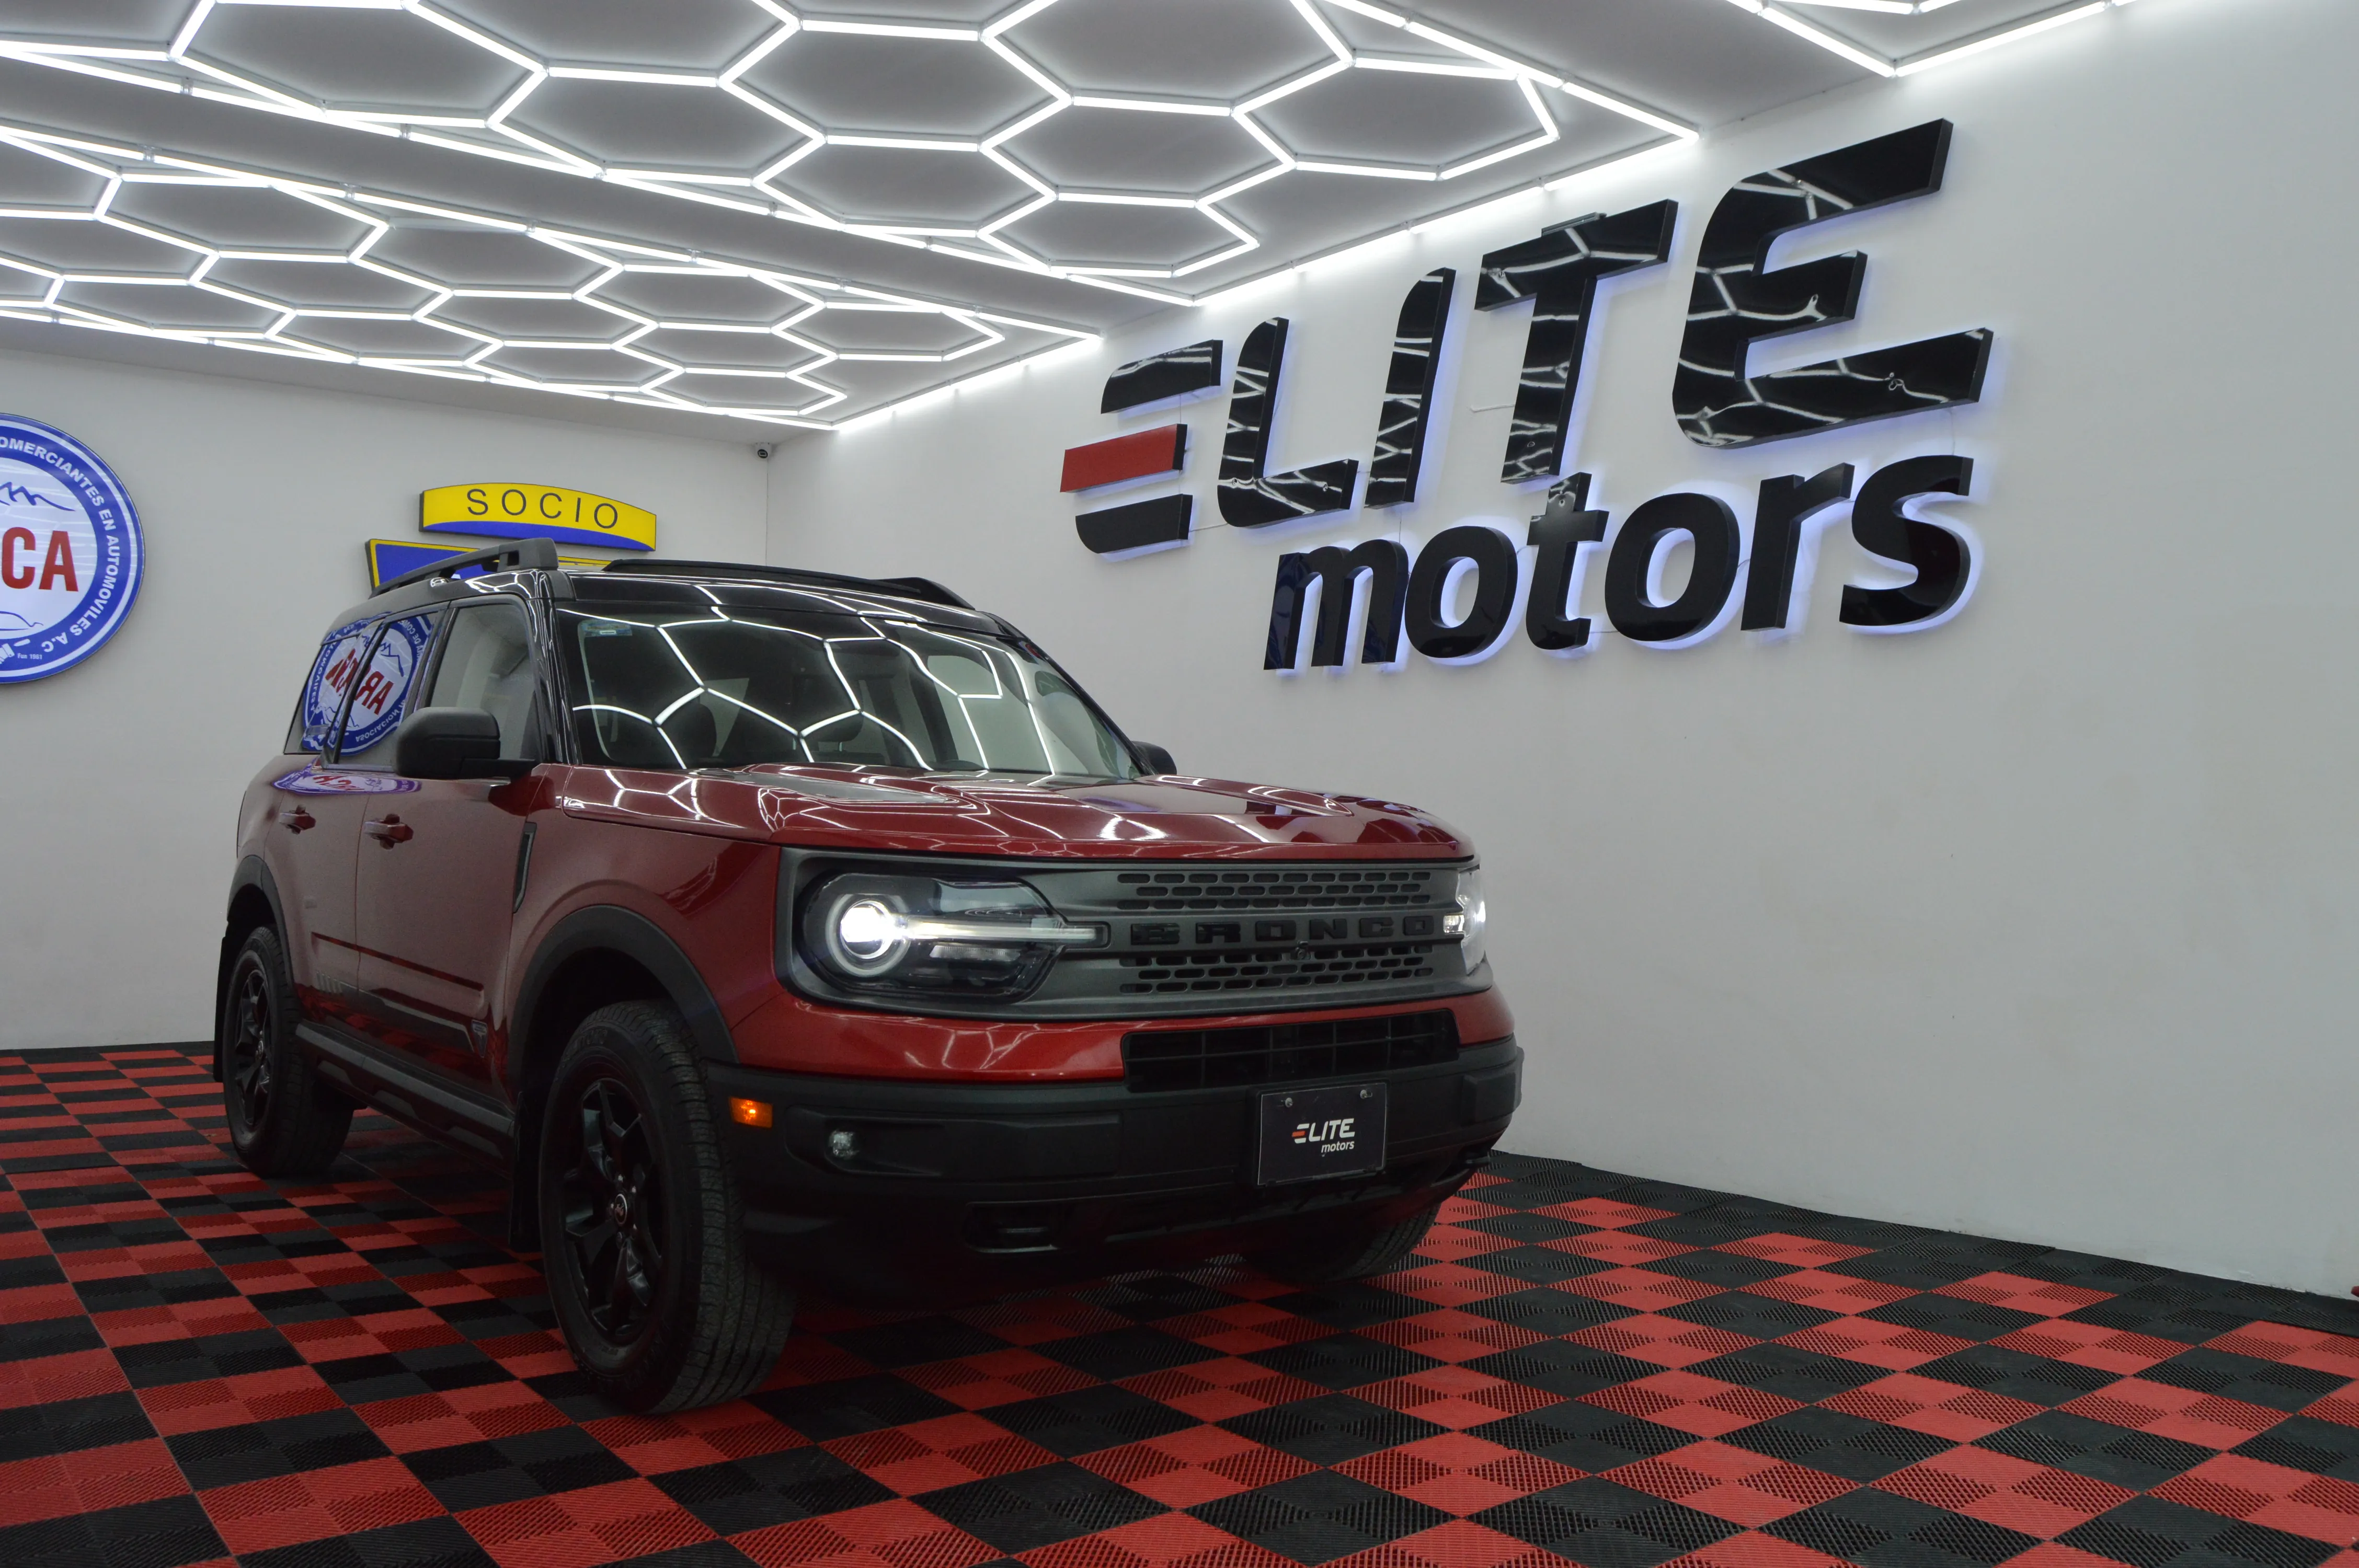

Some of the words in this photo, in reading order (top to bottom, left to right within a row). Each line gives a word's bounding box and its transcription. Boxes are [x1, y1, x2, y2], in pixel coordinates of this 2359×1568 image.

[1059, 117, 1994, 555] ELITE
[98, 509, 117, 531] EN
[466, 488, 619, 529] SOCIO
[2, 527, 79, 592] CA
[1263, 455, 1975, 672] motors
[69, 535, 121, 636] AUTOMOVILES
[1130, 915, 1435, 947] BRONCO
[1291, 1117, 1356, 1144] ELITE
[1321, 1140, 1355, 1154] motors
